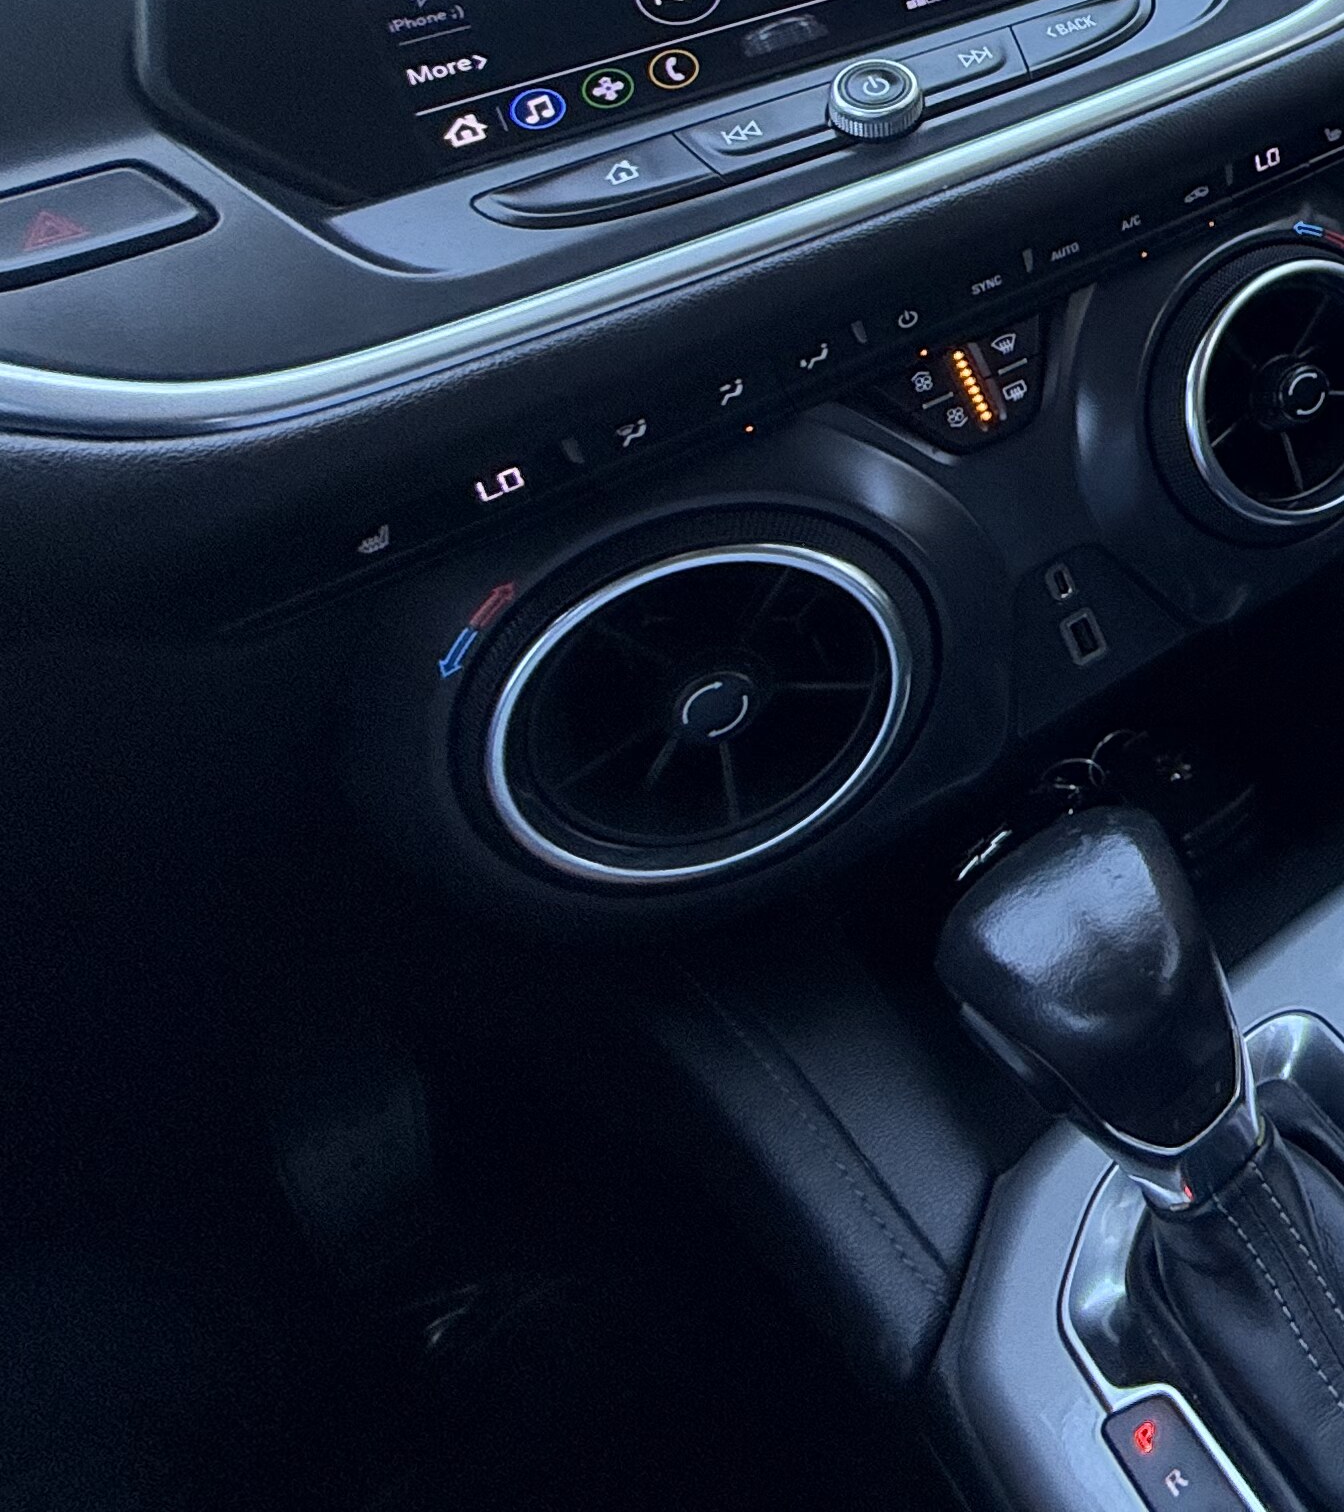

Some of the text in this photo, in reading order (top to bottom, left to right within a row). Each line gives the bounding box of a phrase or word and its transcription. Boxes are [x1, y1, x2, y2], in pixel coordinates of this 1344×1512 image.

[388, 10, 448, 33] iPhone
[1055, 15, 1096, 35] BACK
[407, 60, 472, 85] More
[1255, 148, 1280, 171] LO
[1122, 215, 1140, 230] A/C
[1051, 242, 1080, 262] AUTO
[972, 275, 1001, 294] SYNC
[476, 467, 524, 501] LO
[1135, 1419, 1156, 1455] P
[1165, 1468, 1189, 1497] R
